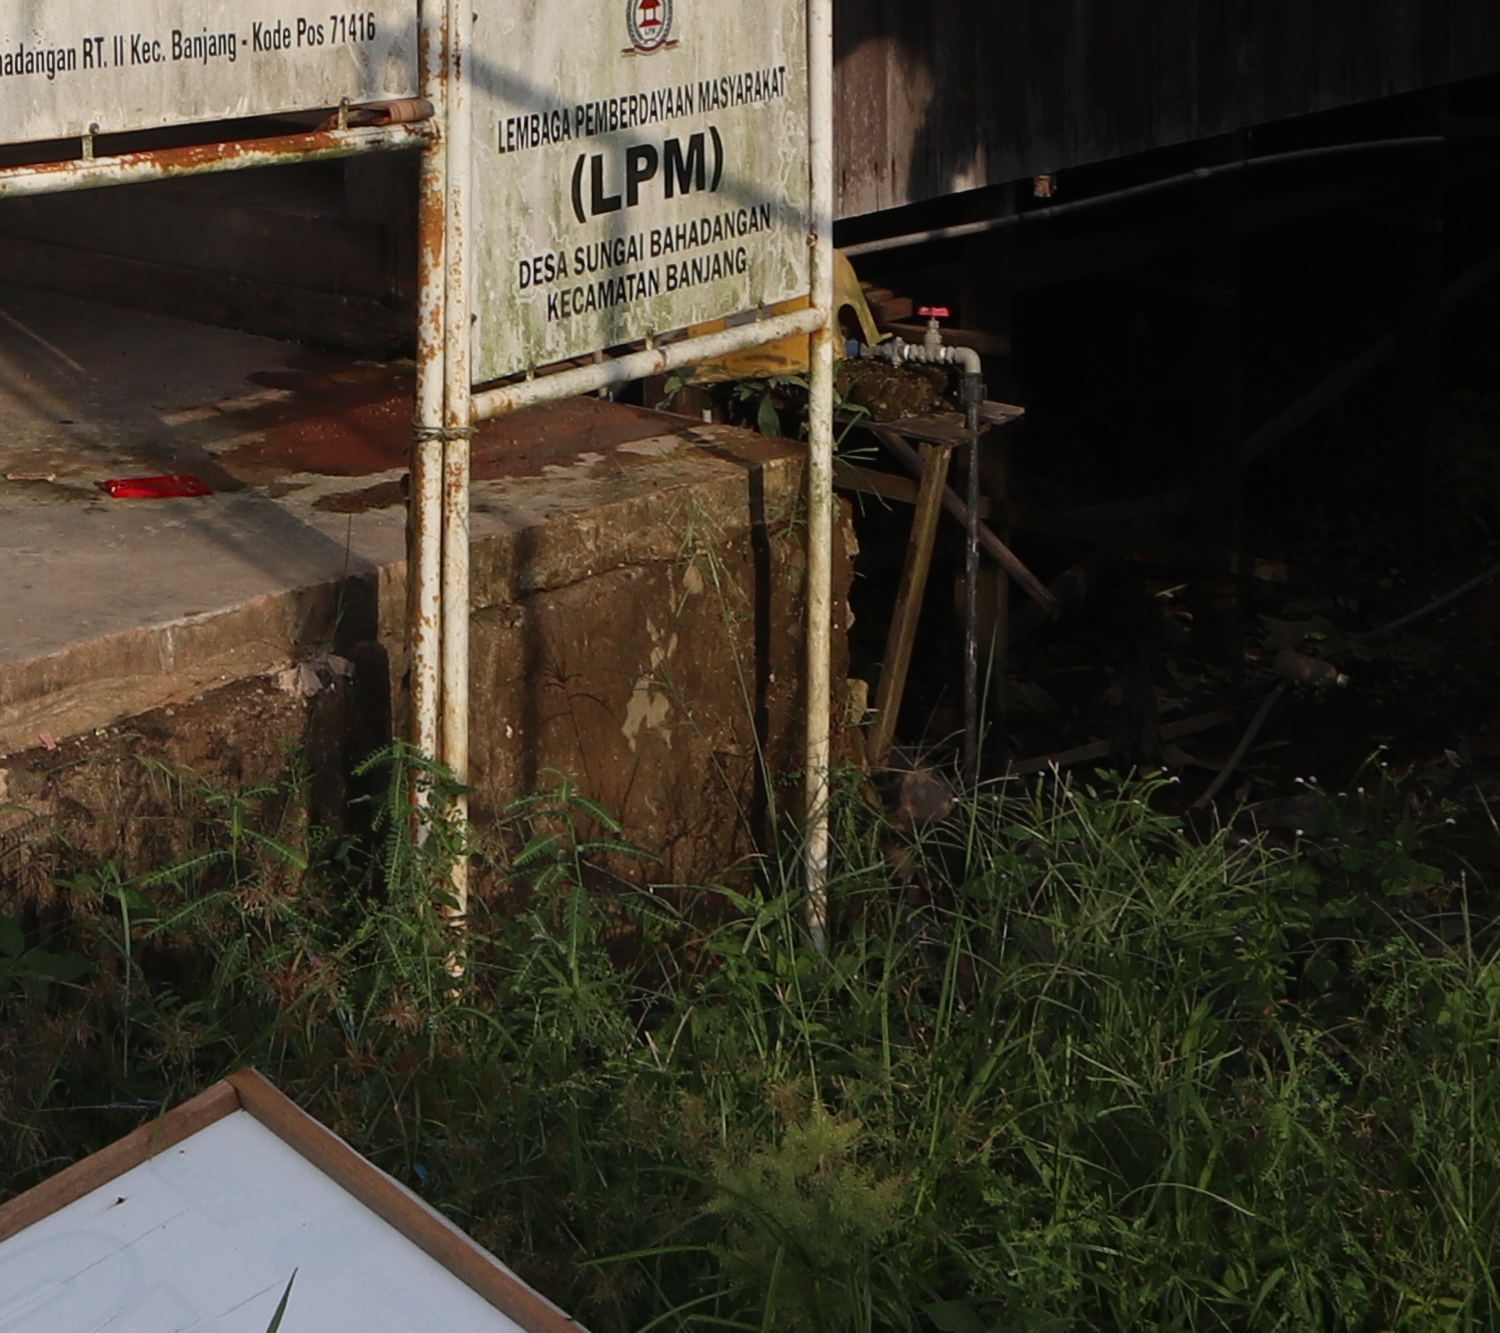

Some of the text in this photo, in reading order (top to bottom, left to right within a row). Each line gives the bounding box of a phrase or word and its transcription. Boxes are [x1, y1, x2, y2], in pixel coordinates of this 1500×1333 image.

[83, 37, 108, 69] RT.
[130, 32, 166, 65] Kec.
[171, 28, 237, 66] Banjang
[252, 20, 291, 52] Kode
[297, 18, 325, 48] Pos
[329, 13, 376, 45] 71416
[497, 66, 785, 154] LEMBAGA PEMBERDAYAAN MASYARAKAT
[571, 126, 724, 223] (LPM)
[519, 204, 771, 289] DESA SUNGAI BAHADANGAN
[548, 249, 746, 322] KECAMATAN BANJANG
